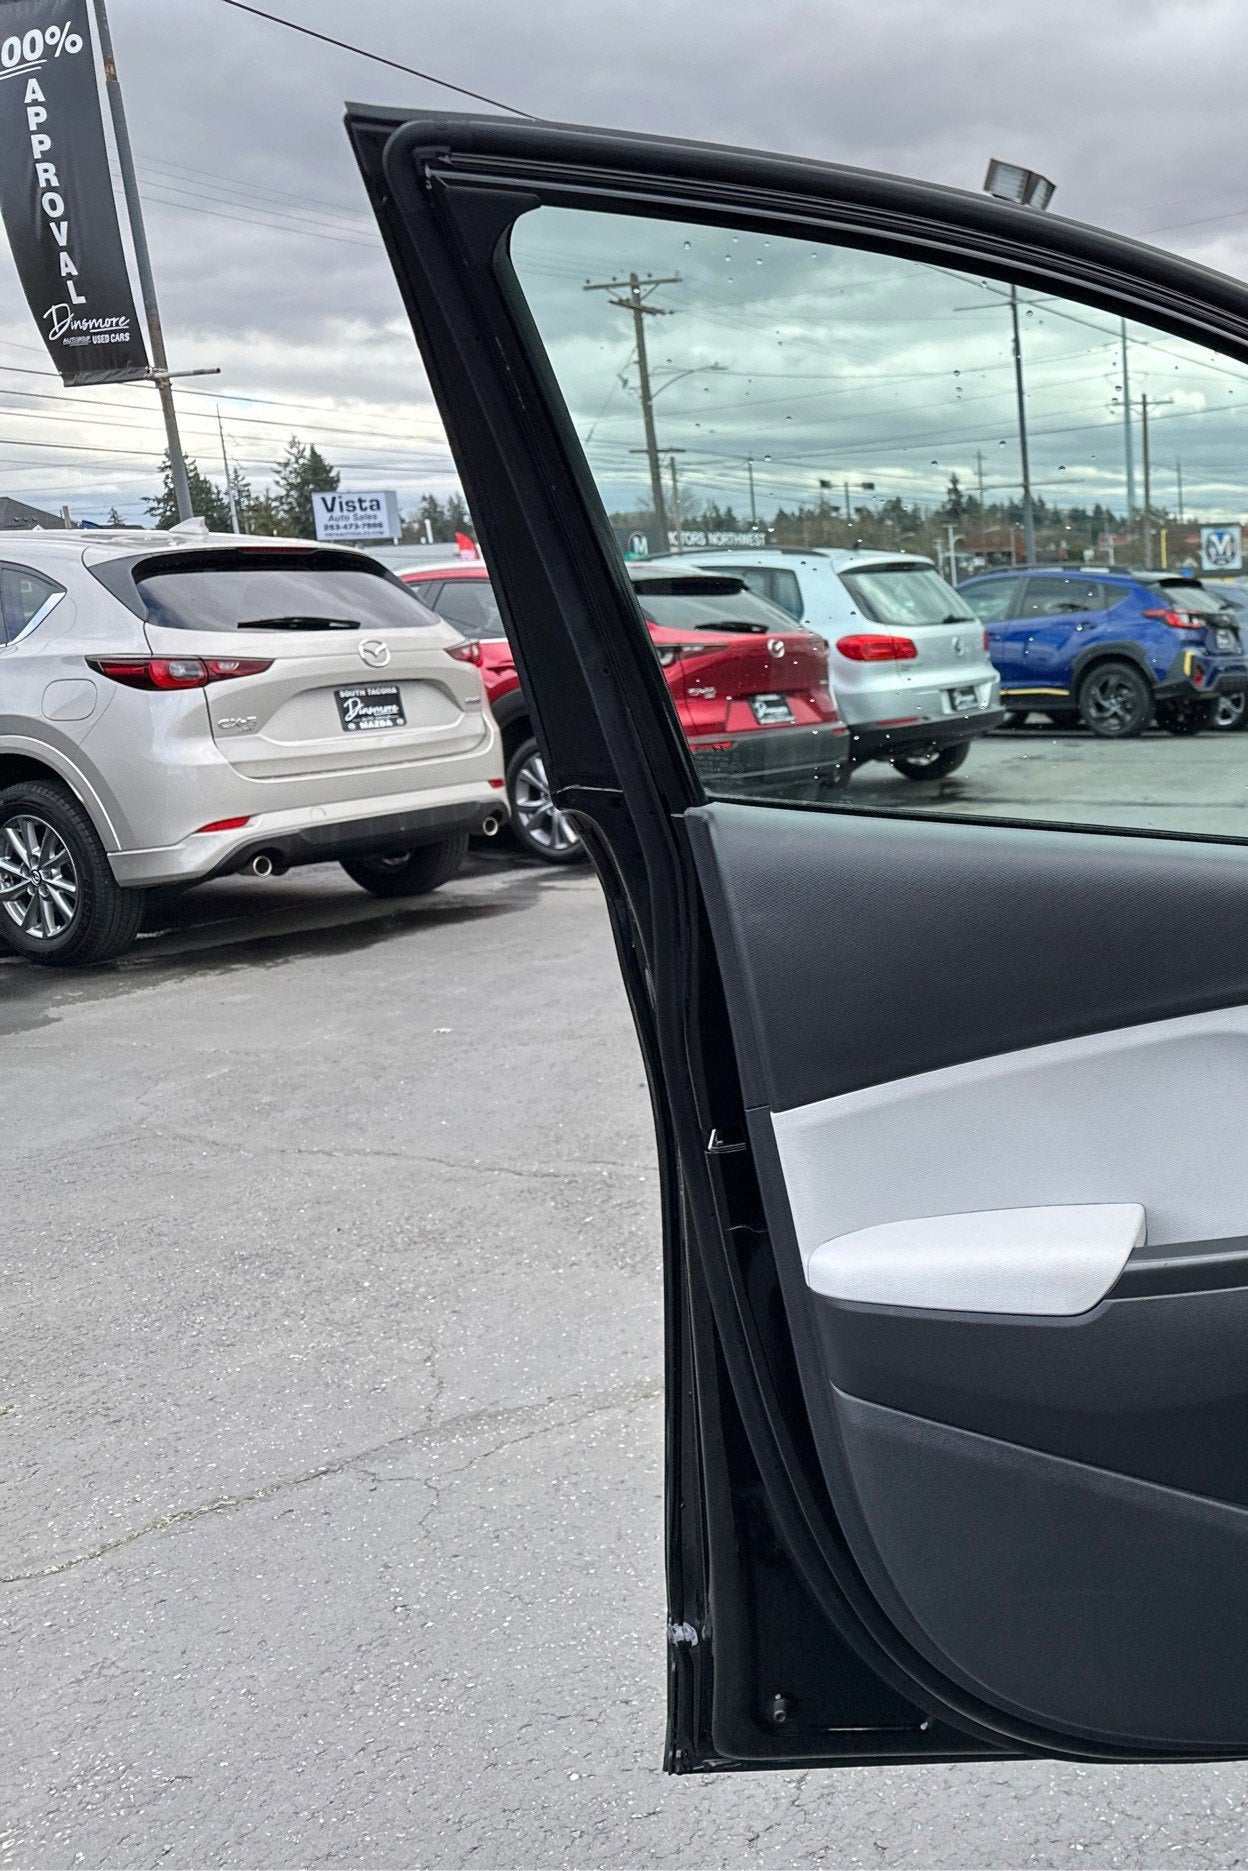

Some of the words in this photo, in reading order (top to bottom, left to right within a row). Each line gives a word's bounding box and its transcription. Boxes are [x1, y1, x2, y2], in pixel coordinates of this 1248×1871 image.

[0, 21, 84, 68] 00%
[24, 78, 86, 304] APPROVAL
[43, 303, 130, 340] Dinsmore
[92, 334, 110, 344] USED
[110, 332, 130, 343] CARS
[321, 495, 381, 513] Vista
[352, 513, 378, 521] Sales
[359, 719, 393, 729] MAZDA
